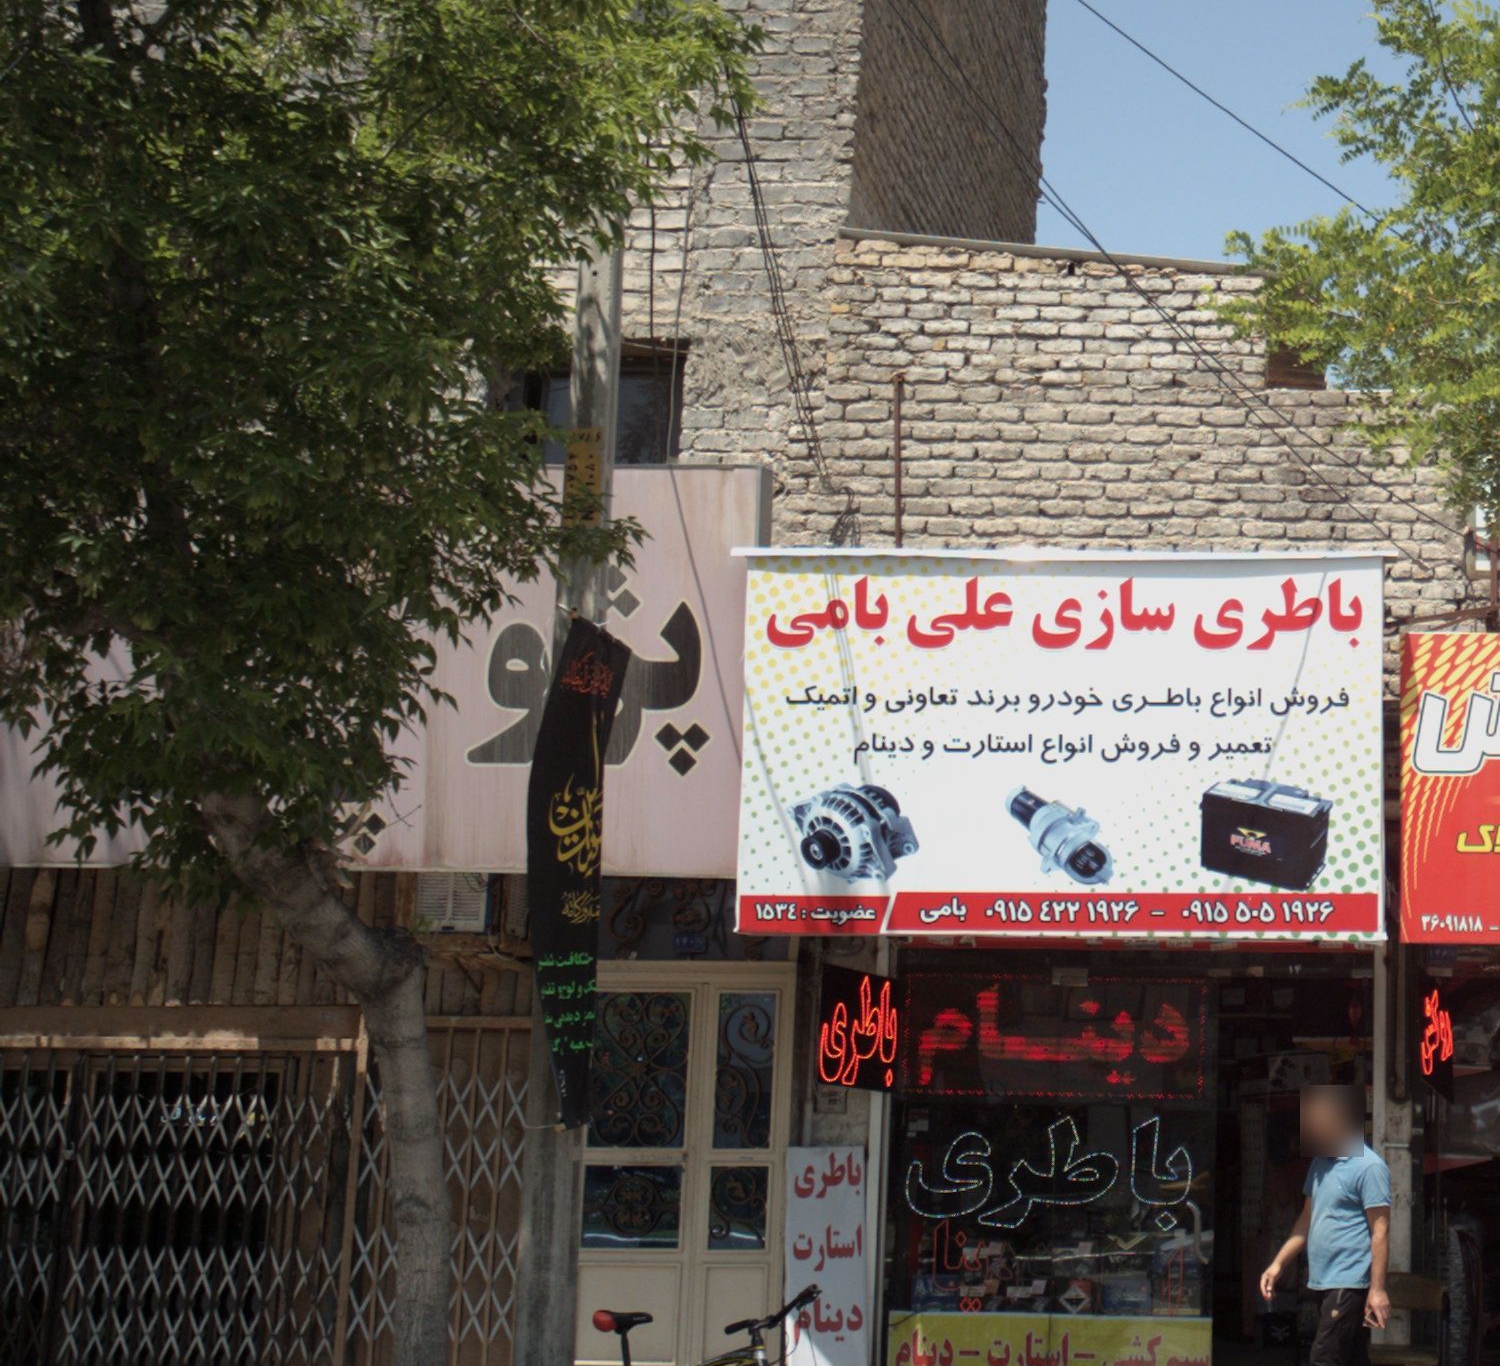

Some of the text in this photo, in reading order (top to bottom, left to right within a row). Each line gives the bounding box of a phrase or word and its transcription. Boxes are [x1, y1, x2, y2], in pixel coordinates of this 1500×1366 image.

[766, 577, 1364, 650] باطری سازی علی بامی
[785, 685, 1350, 717] فروش انواع باطری خودرو برند تعاونی و اتمیک
[853, 733, 1272, 763] تعمیر و فروش انواع استارت و دینام
[810, 904, 876, 925] عضویت
[920, 898, 967, 923] بامی
[819, 974, 897, 1087] باطری
[794, 1152, 862, 1198] باطری
[905, 1116, 1193, 1231] باطری
[793, 1224, 862, 1271] استارت
[794, 1297, 863, 1345] دینام
